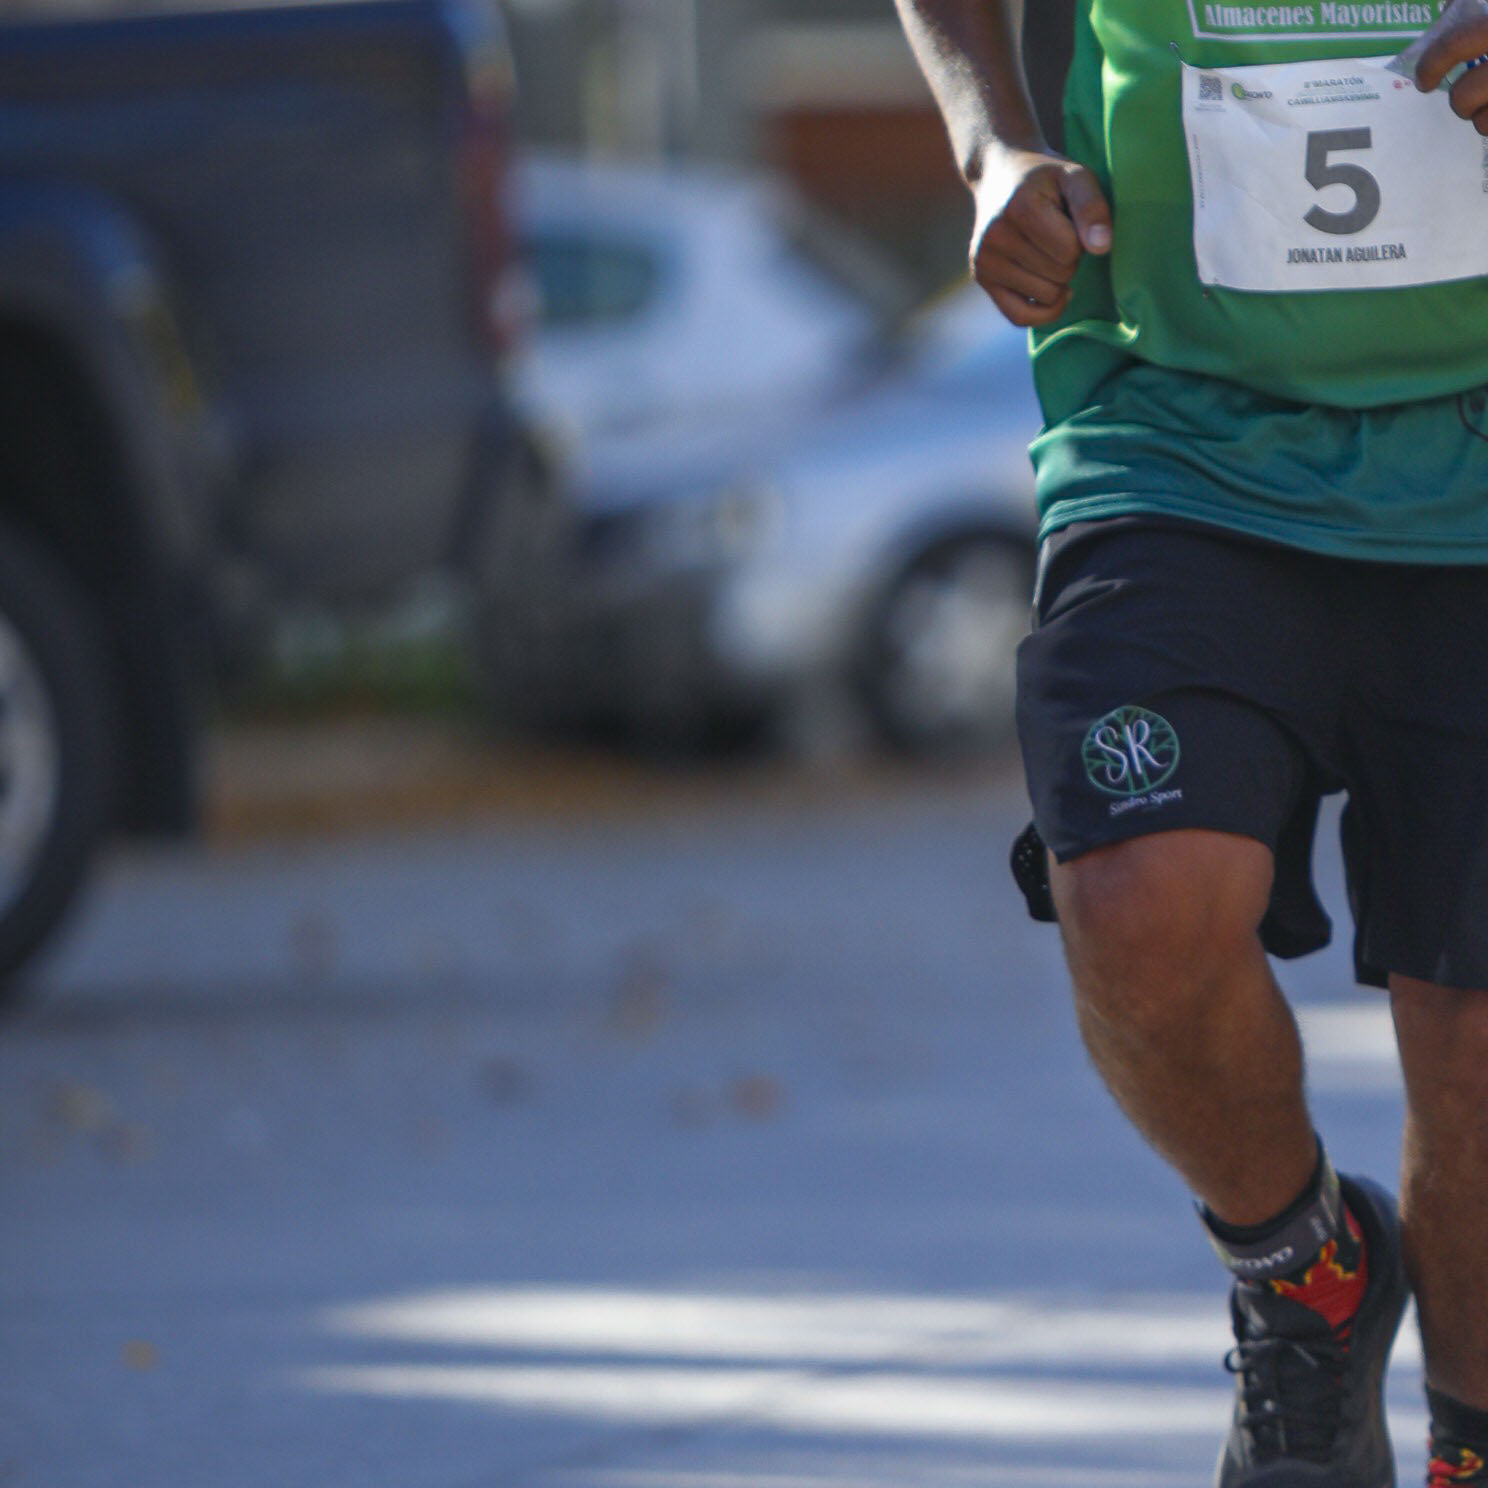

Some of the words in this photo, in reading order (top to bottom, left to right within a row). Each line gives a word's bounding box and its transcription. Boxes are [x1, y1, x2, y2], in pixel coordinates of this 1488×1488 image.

[1204, 3, 1315, 27] Almacenes
[1320, 0, 1433, 28] Mayoristas
[1302, 126, 1382, 236] 5
[1286, 247, 1343, 264] JONATAN
[1346, 242, 1407, 263] AGUILERA
